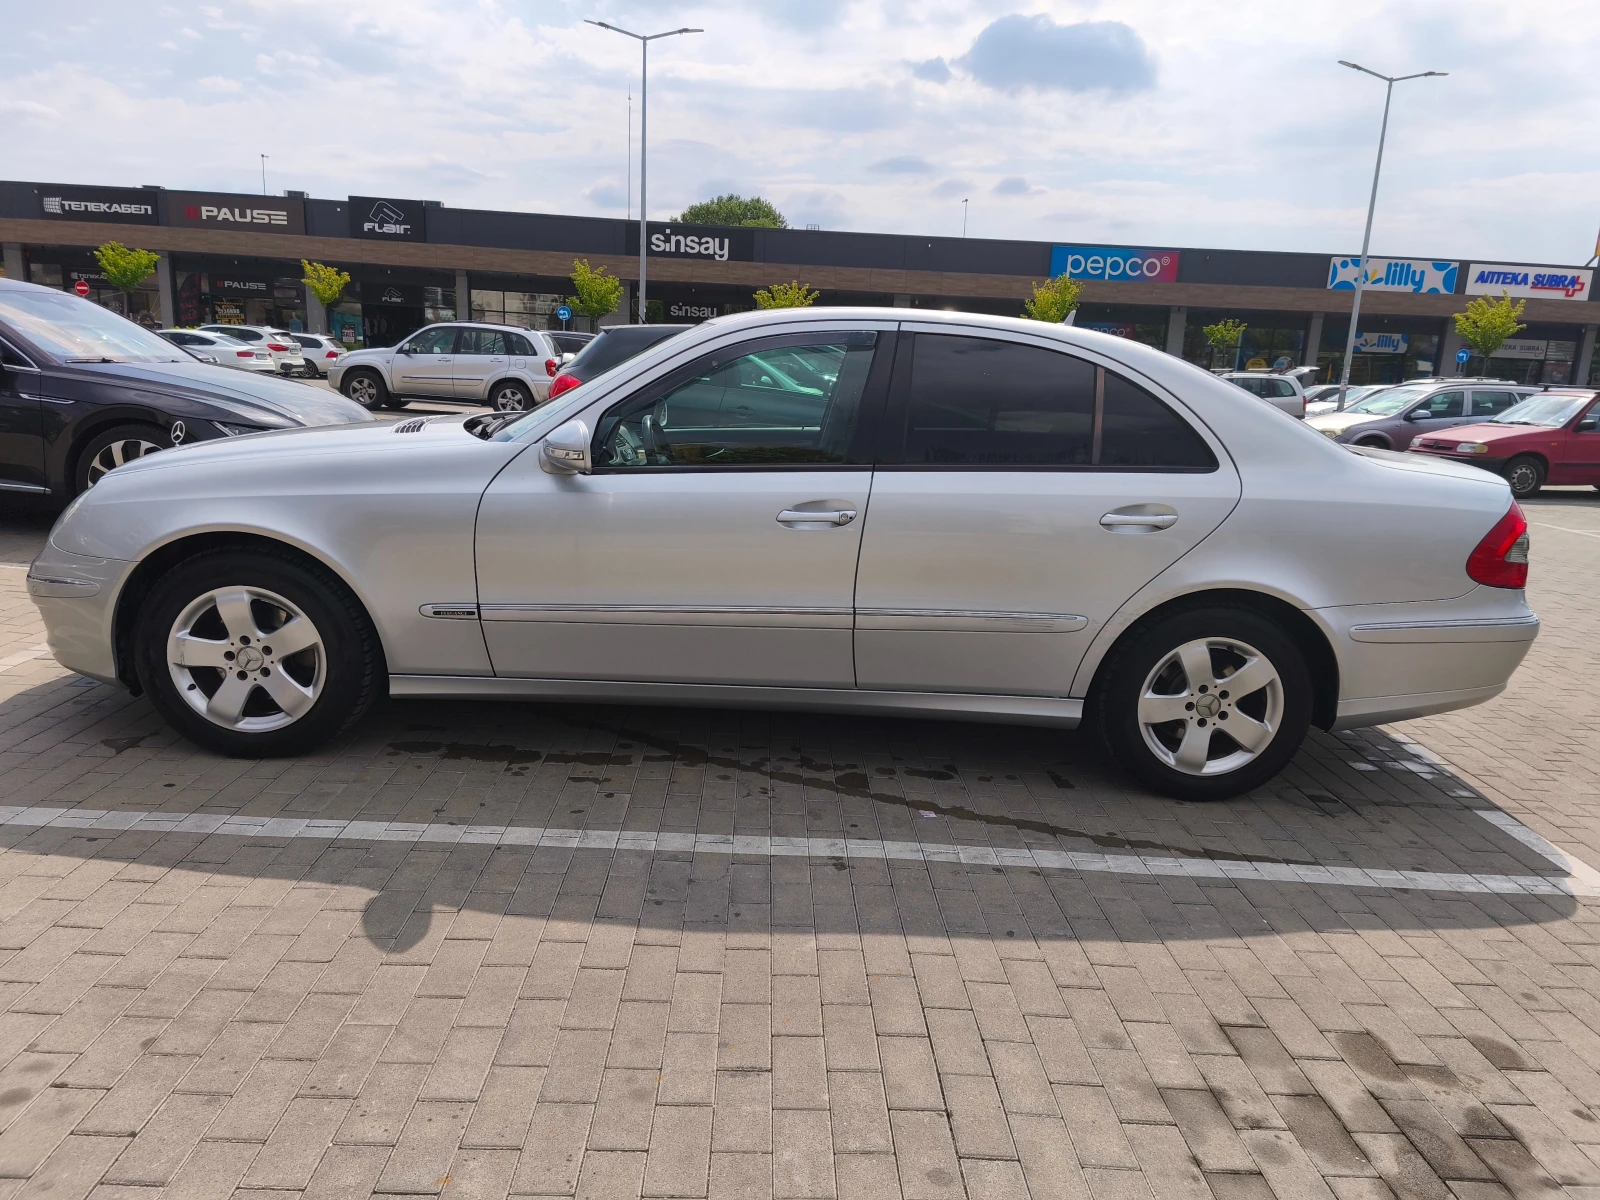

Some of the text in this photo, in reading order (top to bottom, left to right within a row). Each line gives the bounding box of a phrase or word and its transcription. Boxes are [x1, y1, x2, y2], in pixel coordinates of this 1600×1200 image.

[62, 200, 153, 215] ТЕЛЕКАБЕЛ
[201, 206, 288, 225] PAUSE
[651, 228, 730, 261] sinsay
[1066, 254, 1161, 280] pepco
[224, 280, 267, 291] PAUSE
[1384, 262, 1426, 294] lilly
[1475, 270, 1577, 288] АПТЕКА SUBRA
[670, 302, 718, 320] sinsay
[1377, 334, 1400, 352] lilly
